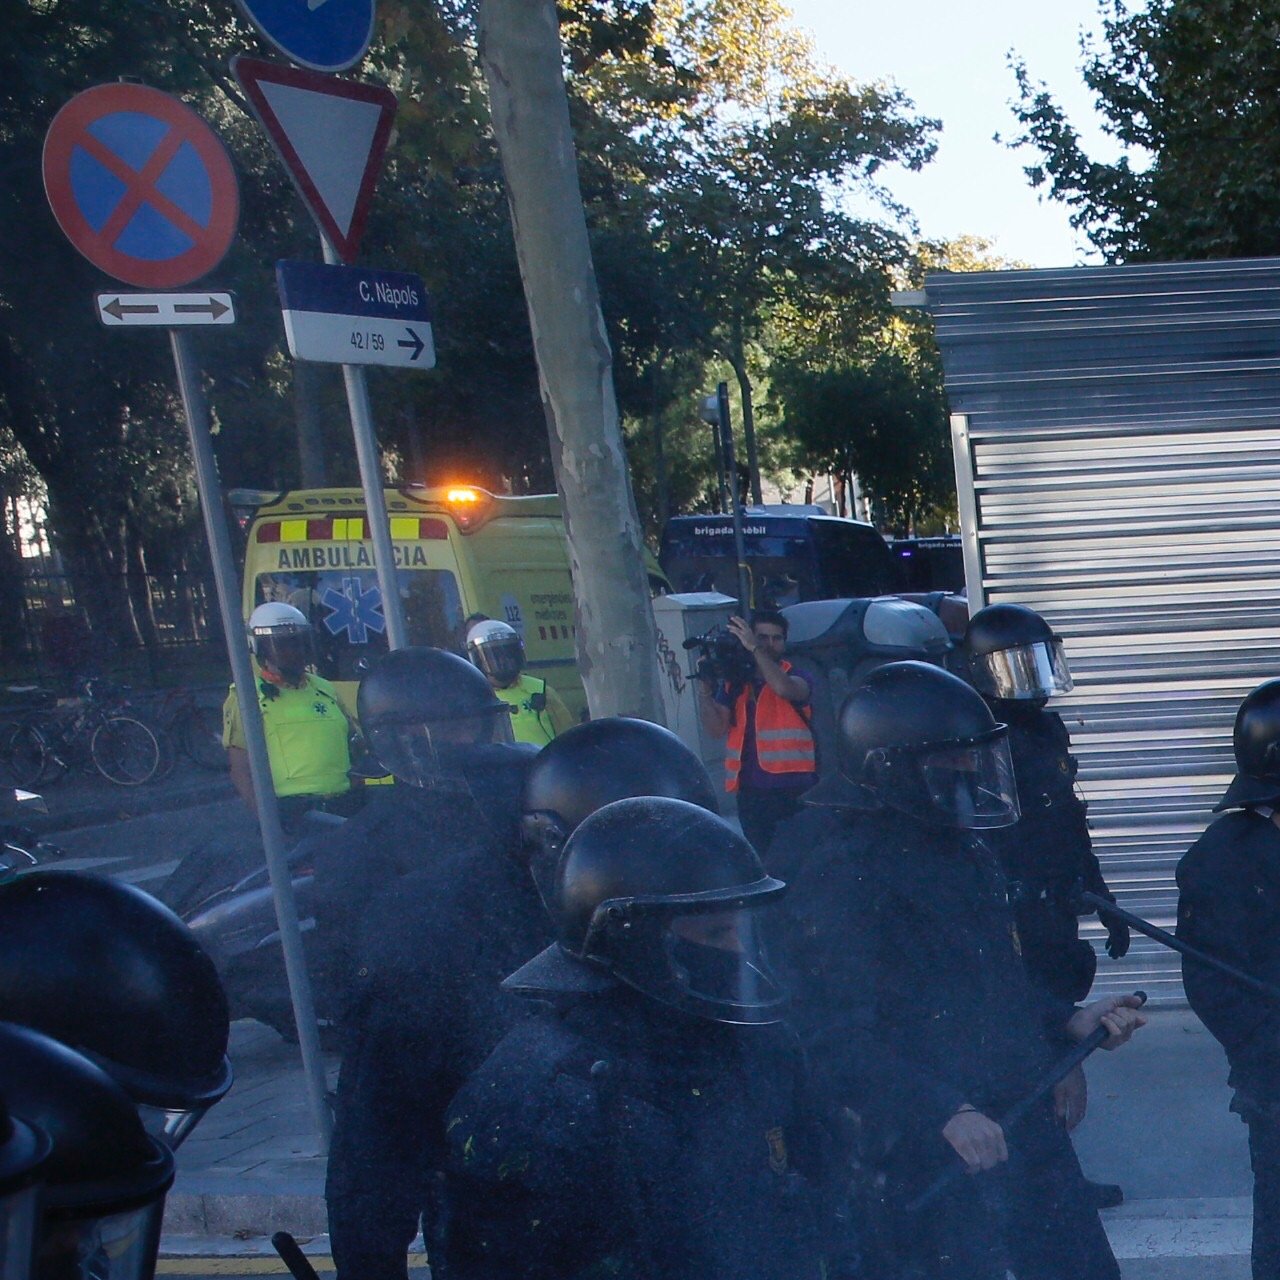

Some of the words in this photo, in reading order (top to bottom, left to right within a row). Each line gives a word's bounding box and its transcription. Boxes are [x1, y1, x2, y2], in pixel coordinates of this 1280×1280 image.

[359, 280, 374, 302] C.
[375, 281, 419, 309] Nàpols
[695, 526, 734, 536] brigada
[278, 541, 428, 569] AMBULÀCIA
